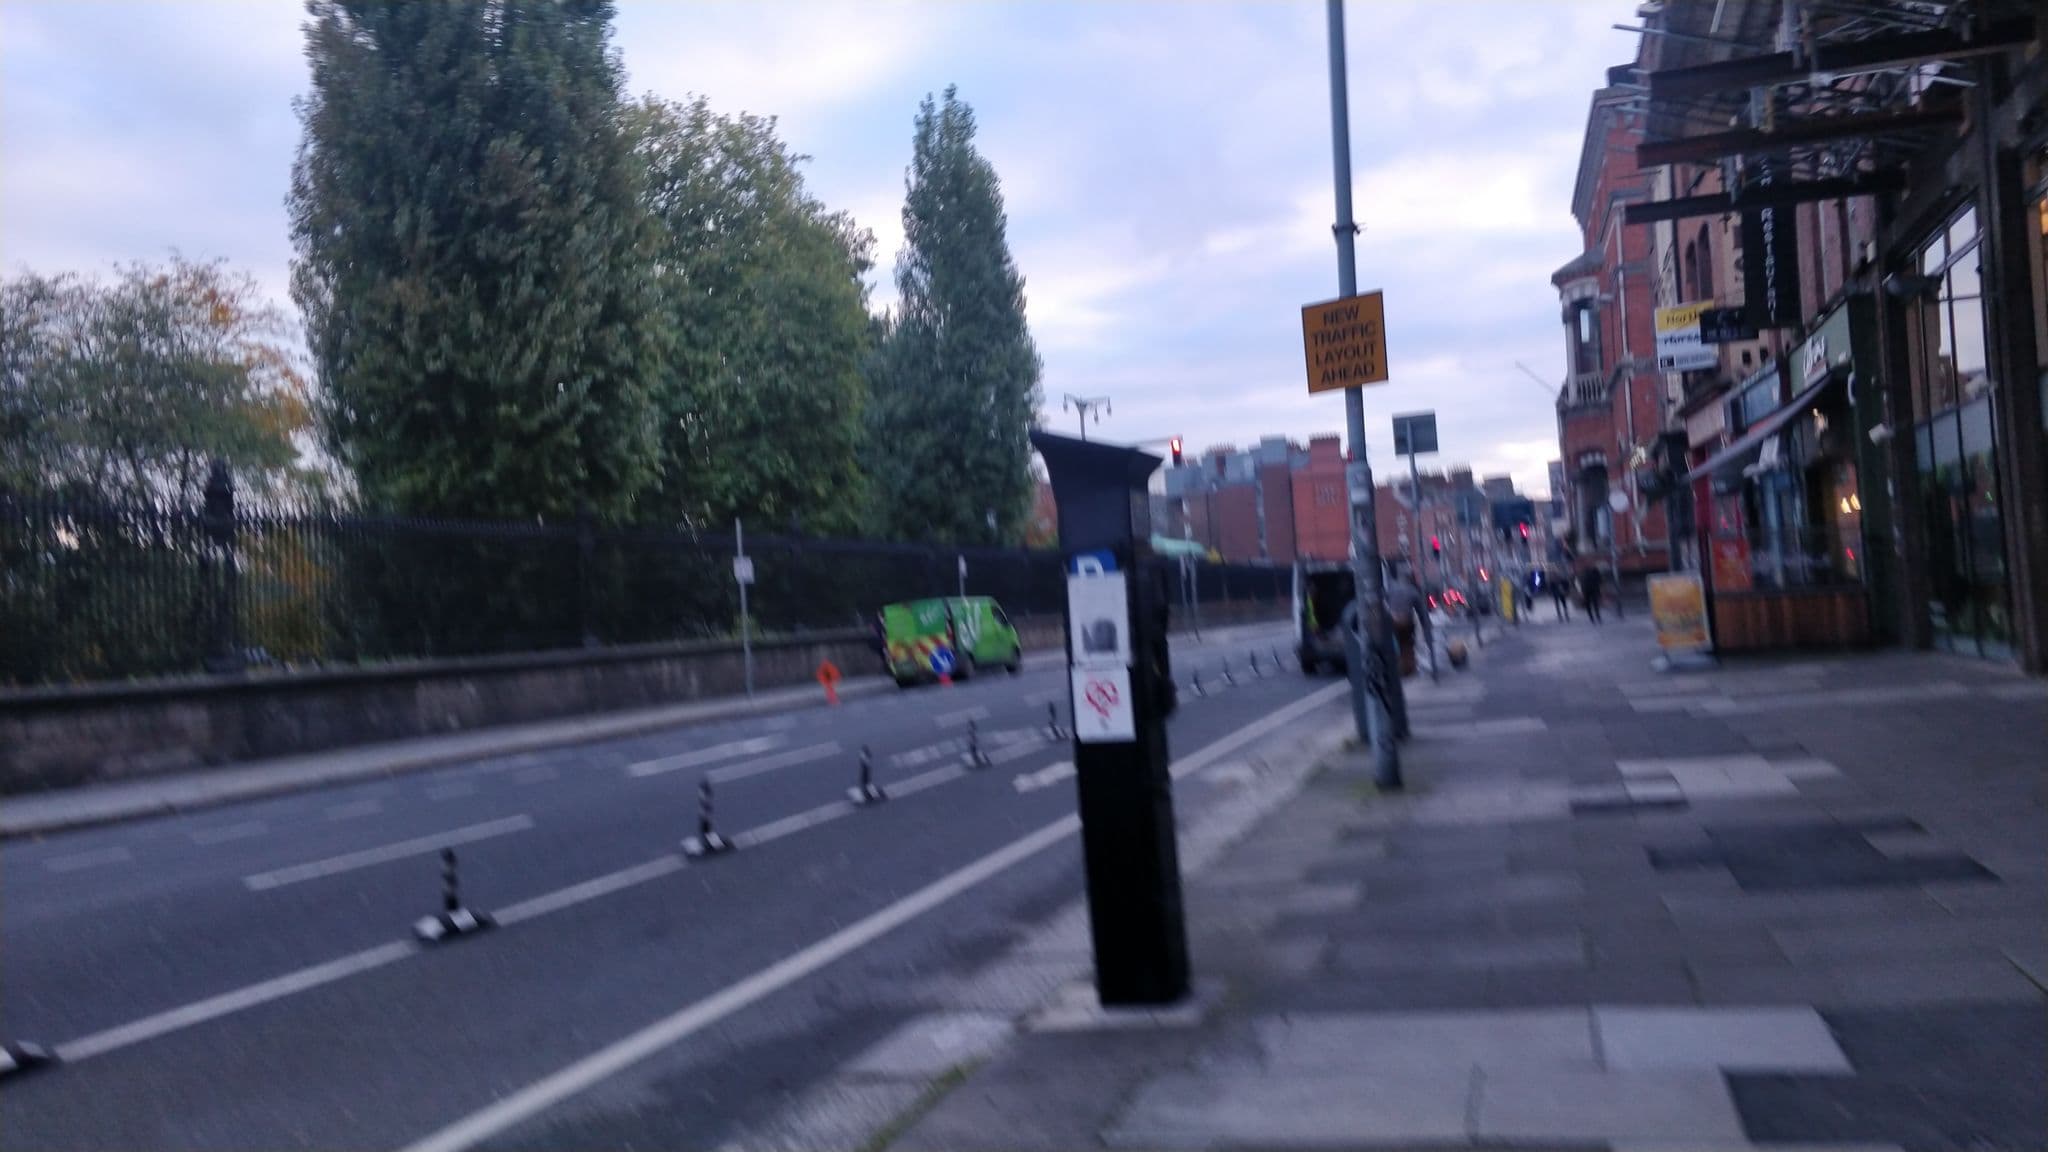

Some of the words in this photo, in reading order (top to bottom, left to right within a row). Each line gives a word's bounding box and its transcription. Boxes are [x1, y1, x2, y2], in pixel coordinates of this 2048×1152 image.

[1323, 304, 1359, 326] NEW
[1313, 321, 1376, 347] TRAFFIC
[1315, 341, 1376, 367] LAYOUT
[1321, 361, 1375, 384] AHEAD
